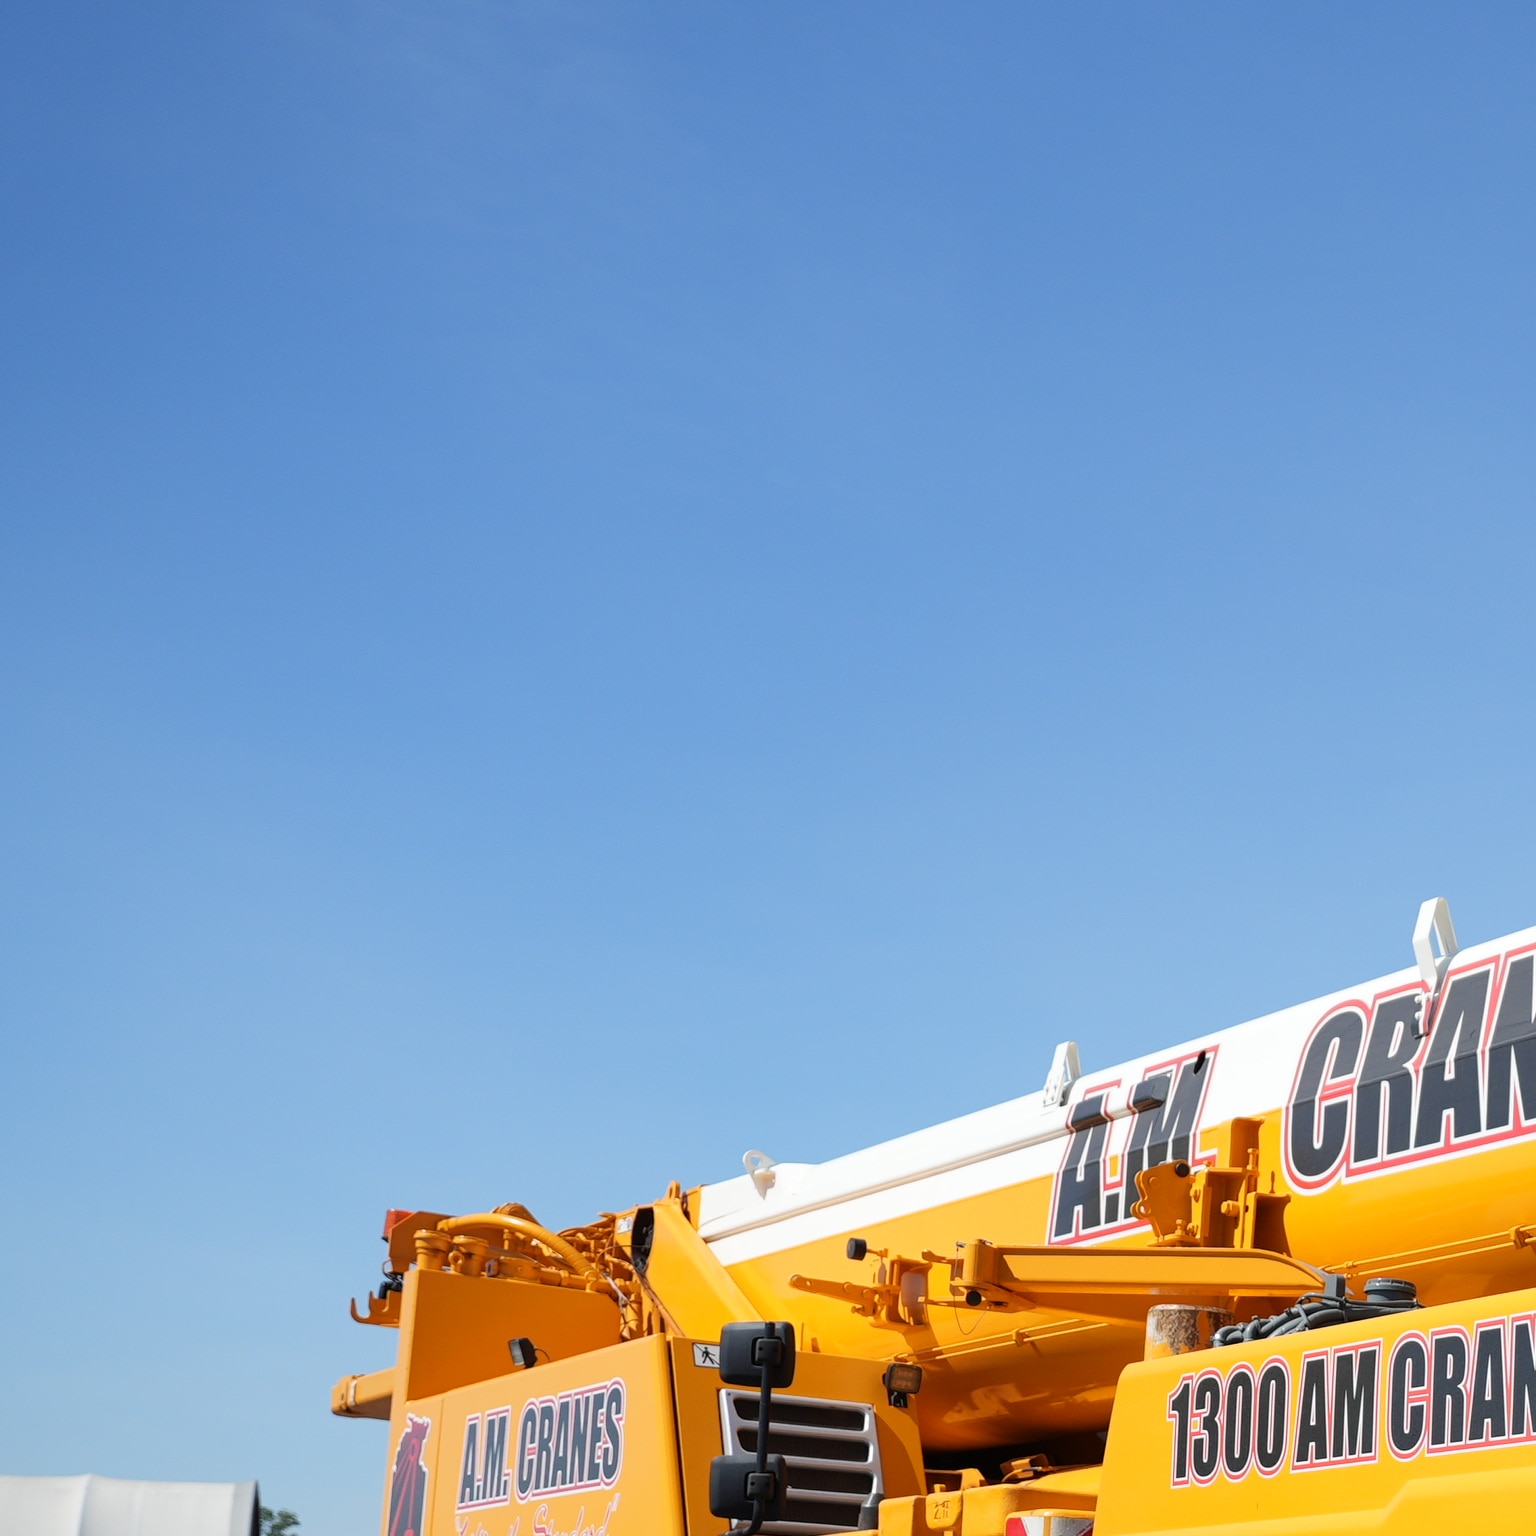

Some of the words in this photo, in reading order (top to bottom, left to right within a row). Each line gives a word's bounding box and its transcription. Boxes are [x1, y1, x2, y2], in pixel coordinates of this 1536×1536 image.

[458, 1409, 512, 1508] A.M.
[514, 1380, 625, 1503] CRANES
[1168, 1357, 1290, 1486] 1300
[1292, 1339, 1382, 1472] AM
